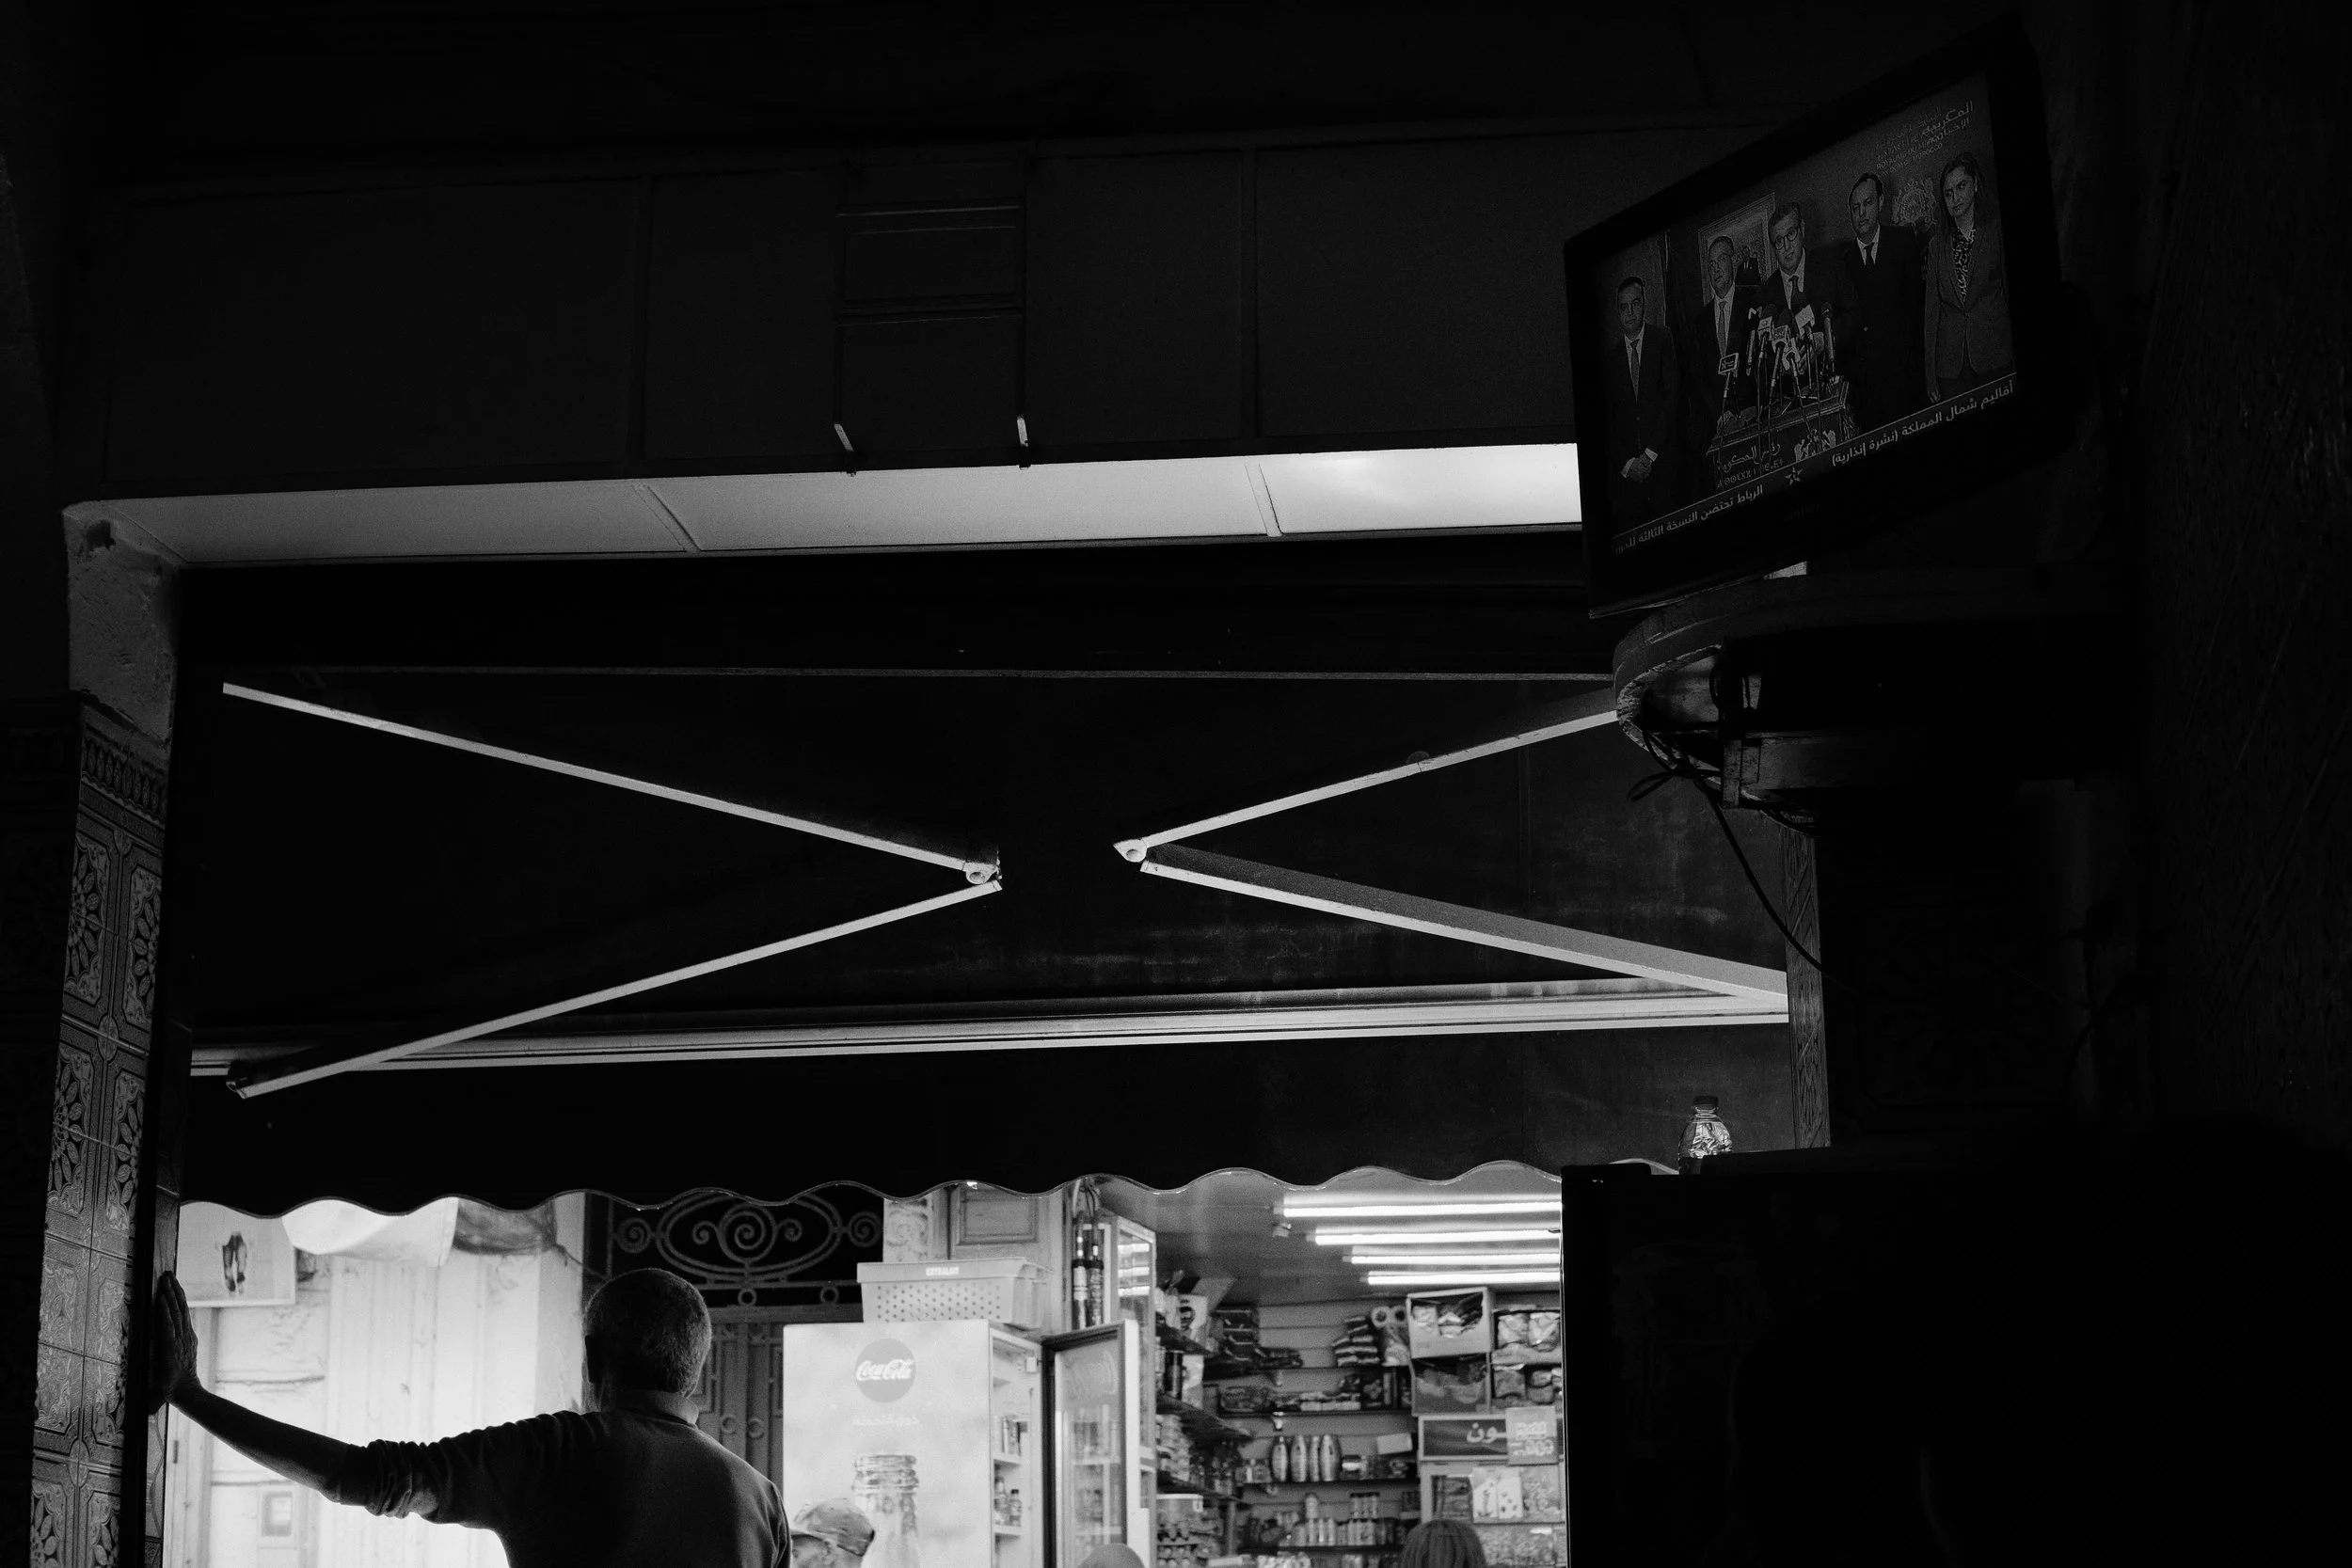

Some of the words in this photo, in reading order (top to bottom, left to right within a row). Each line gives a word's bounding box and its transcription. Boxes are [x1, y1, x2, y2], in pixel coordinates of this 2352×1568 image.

[1980, 378, 2012, 410] أقاليم
[1946, 396, 1977, 421] شمال
[1901, 410, 1943, 436] المملكة
[1736, 483, 1763, 504] الرباط
[1700, 497, 1734, 520] تحتضن
[1665, 511, 1698, 531] النسخة
